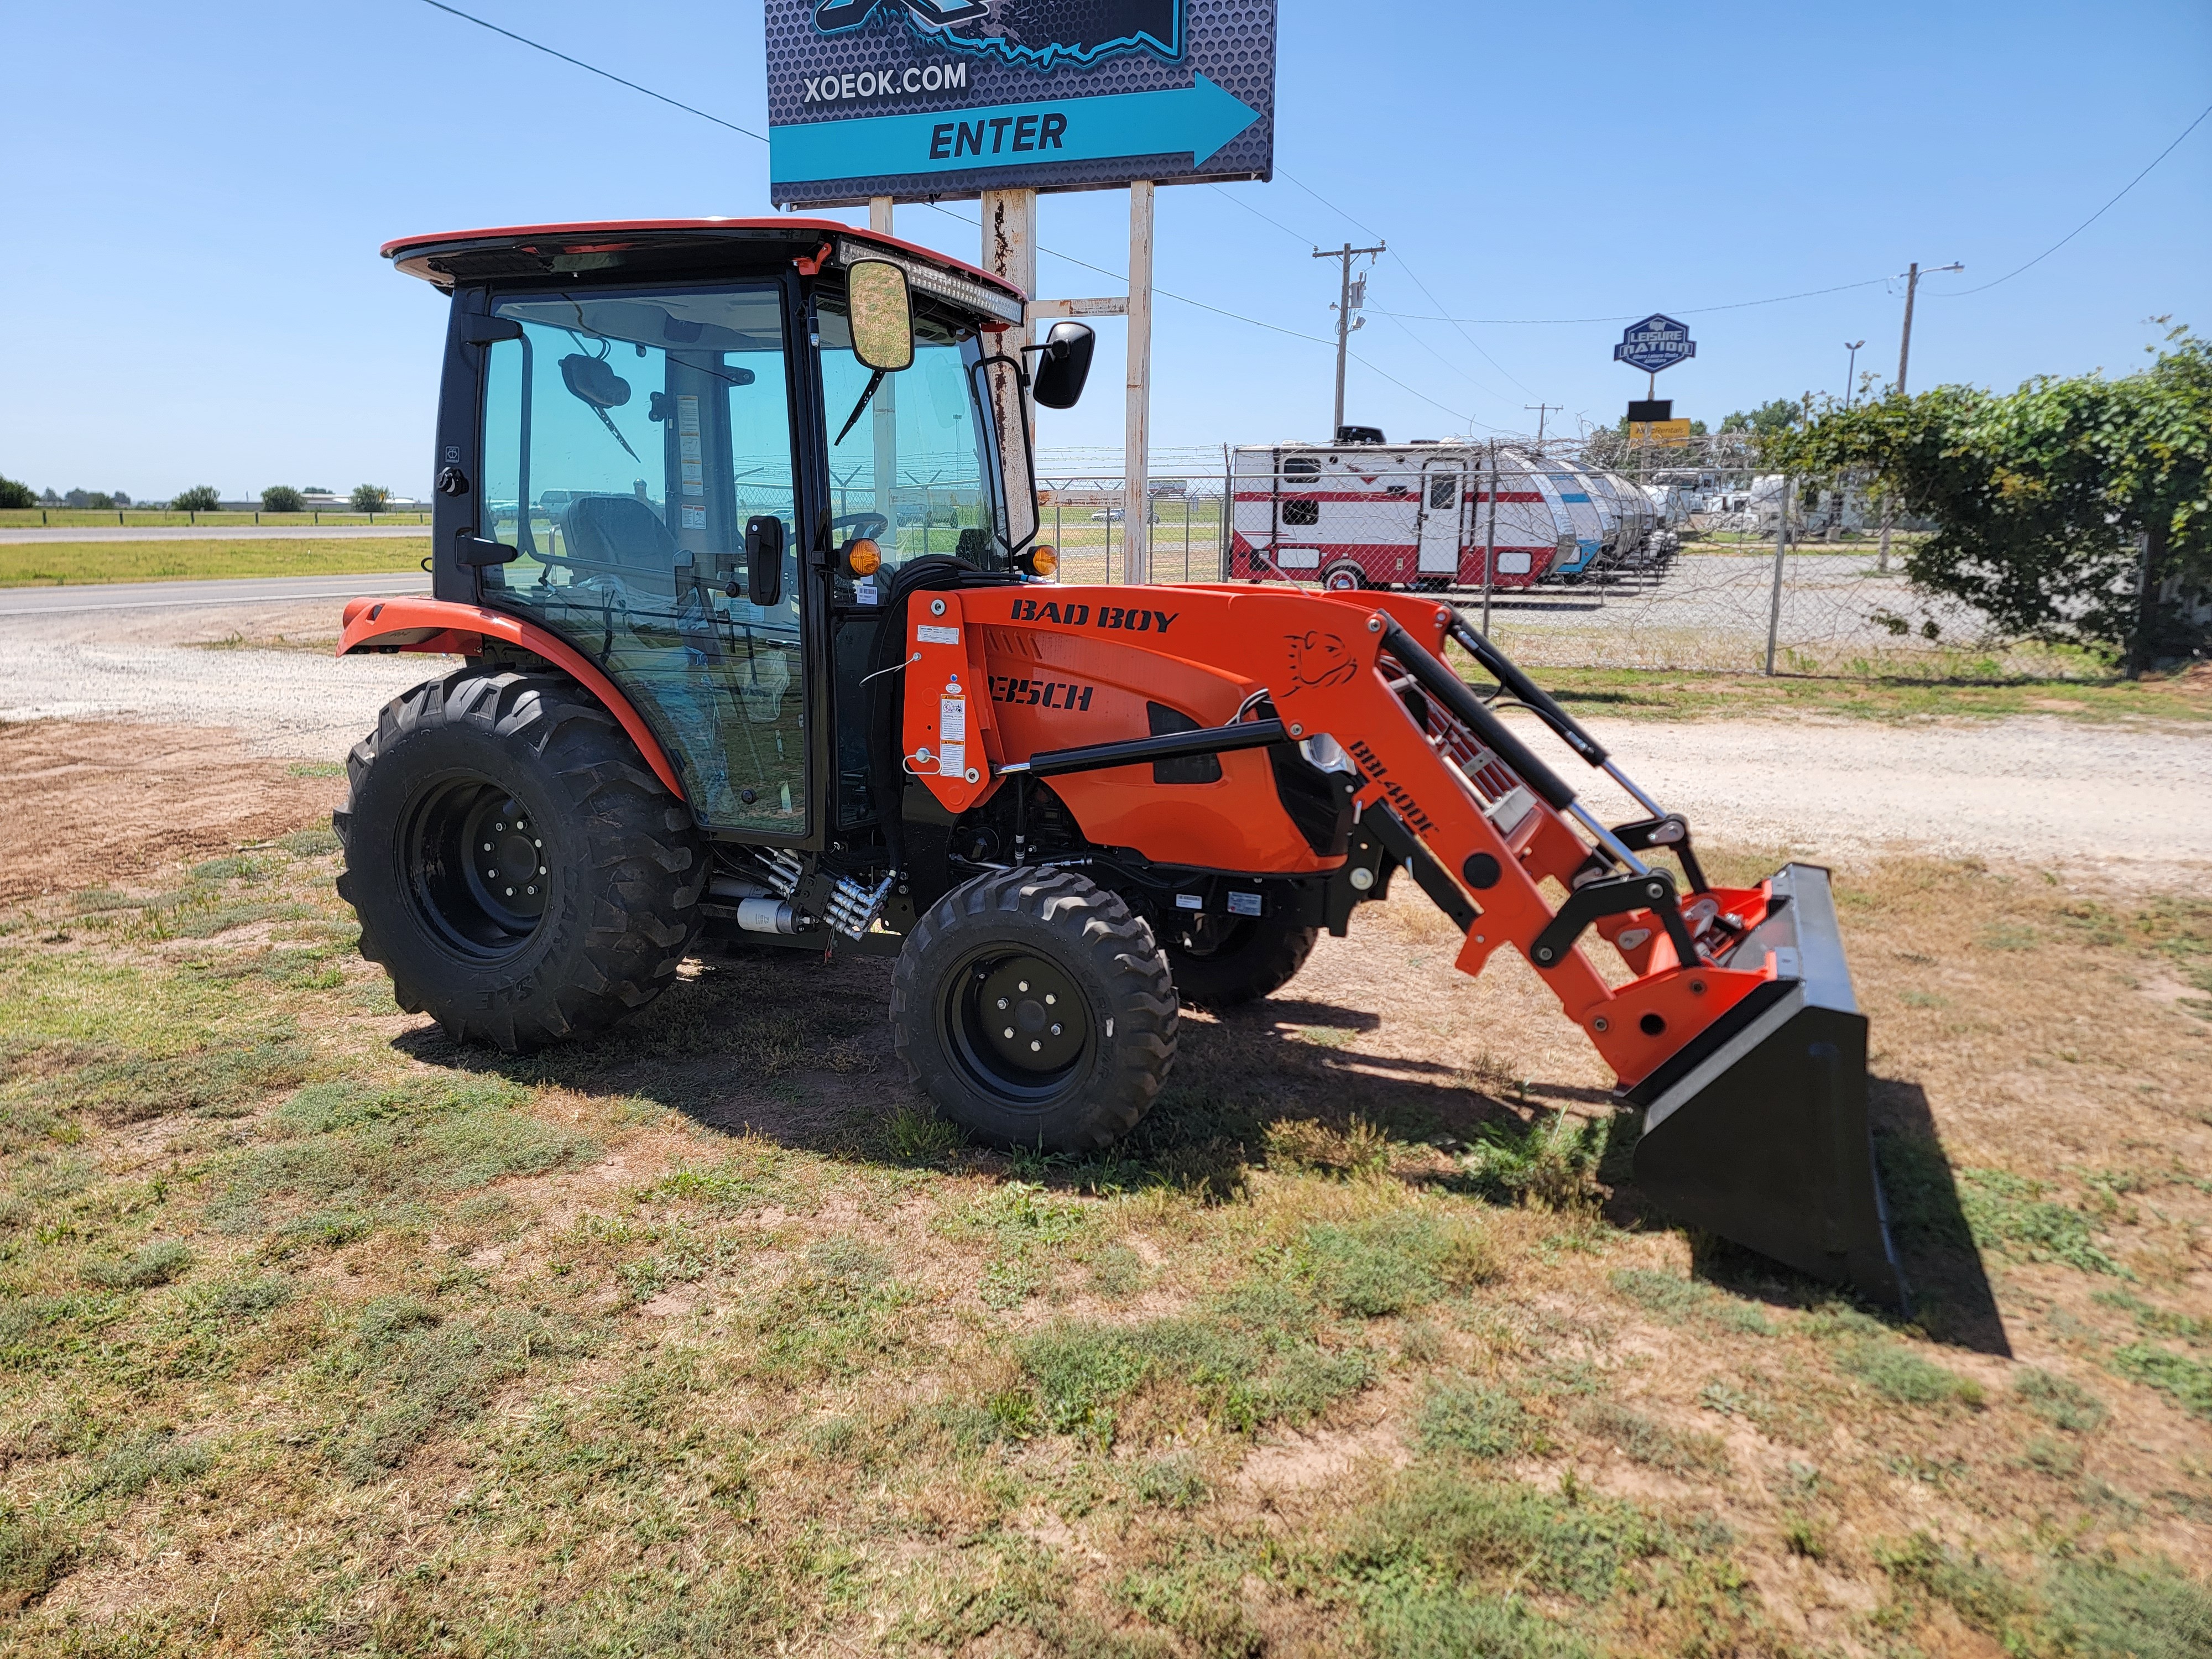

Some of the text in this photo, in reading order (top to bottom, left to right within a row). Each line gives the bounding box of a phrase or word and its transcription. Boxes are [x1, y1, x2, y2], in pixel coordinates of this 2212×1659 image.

[803, 62, 967, 103] XOEOK.COM
[928, 112, 1068, 160] ENTER
[1631, 331, 1683, 343] LEISURE
[1010, 599, 1179, 633] BAD BOY
